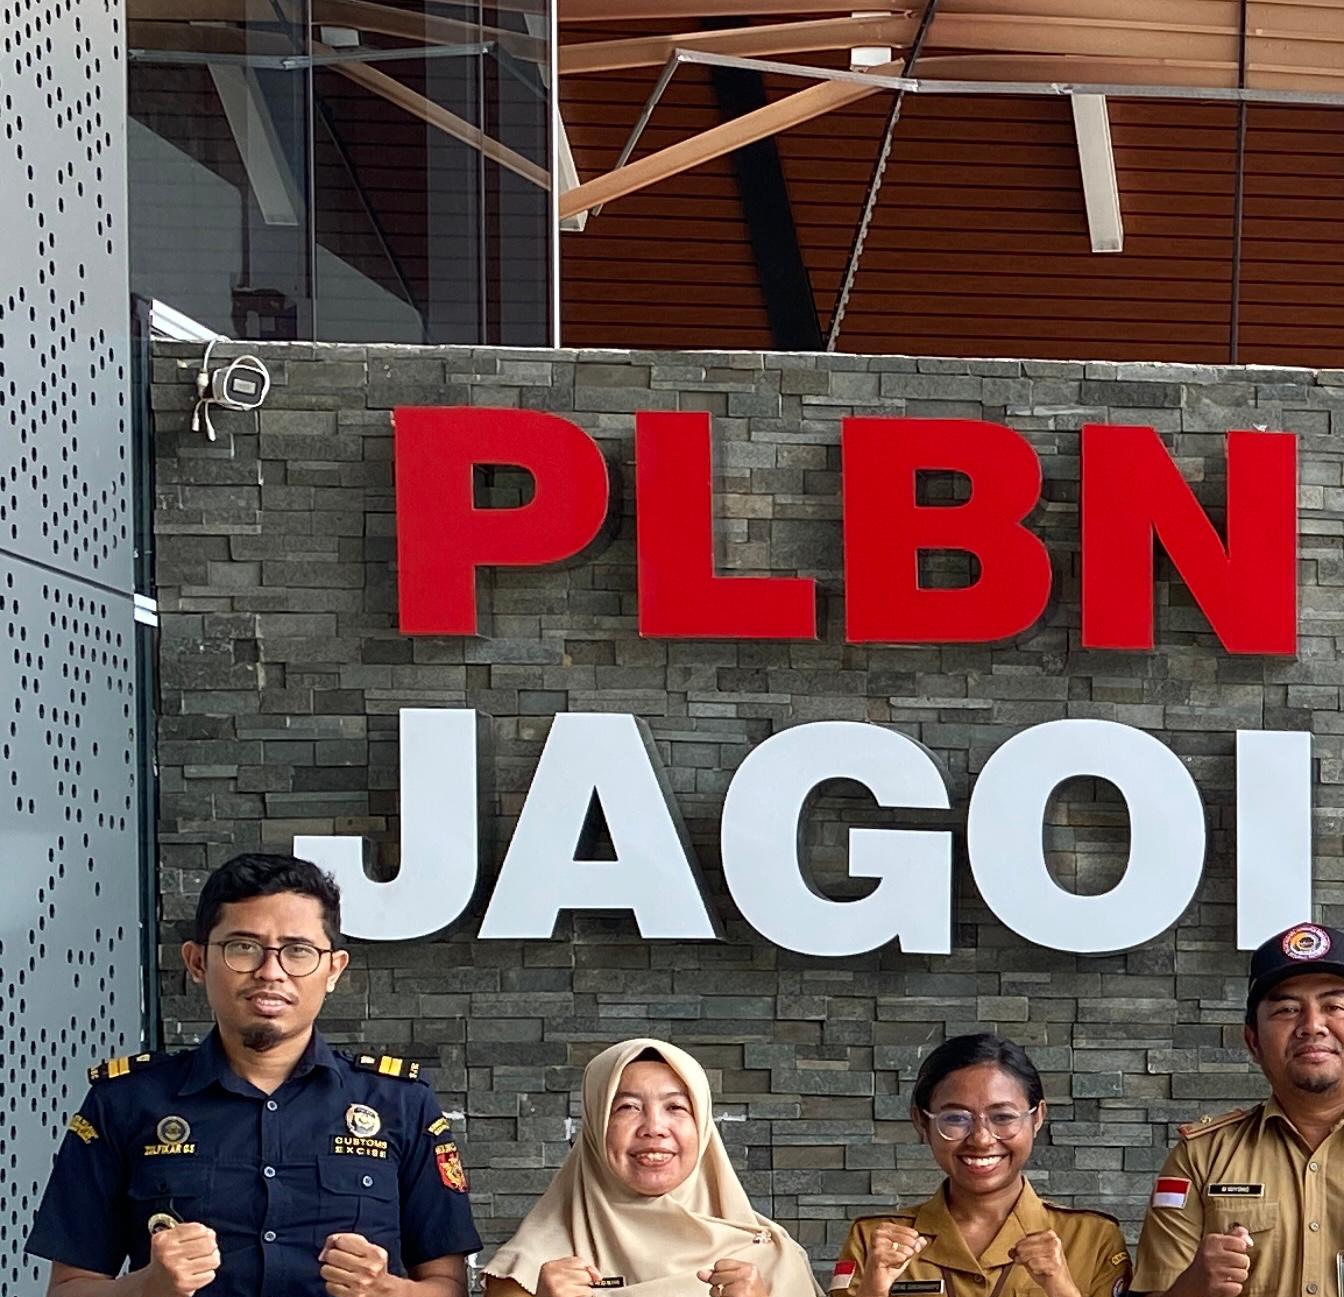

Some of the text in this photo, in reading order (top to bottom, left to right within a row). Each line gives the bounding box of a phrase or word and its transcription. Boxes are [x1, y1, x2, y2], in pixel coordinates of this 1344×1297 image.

[393, 406, 1298, 656] PLBN
[293, 707, 1312, 957] JAGOI
[334, 1136, 388, 1149] CUSTOMS
[334, 1145, 387, 1159] EXCISE
